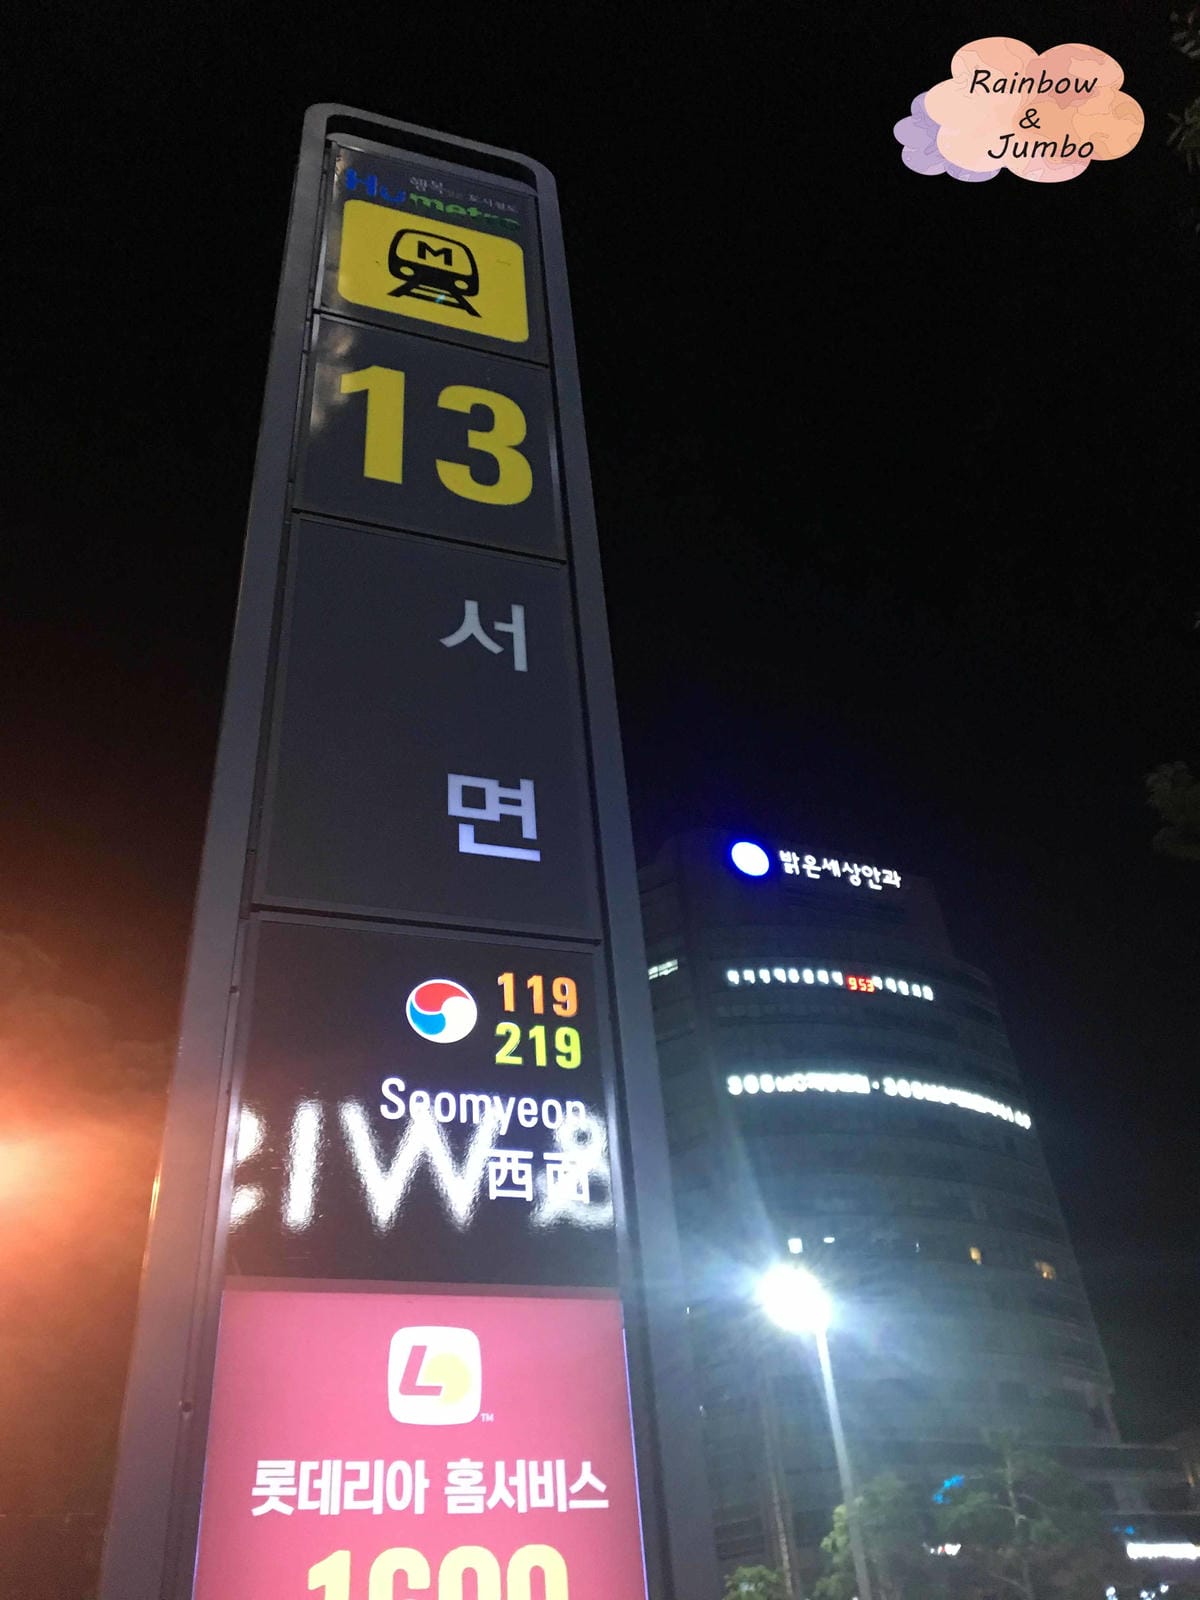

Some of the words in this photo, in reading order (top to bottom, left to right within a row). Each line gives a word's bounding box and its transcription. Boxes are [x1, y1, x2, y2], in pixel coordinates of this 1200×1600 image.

[416, 240, 453, 267] M
[339, 364, 534, 506] 13
[439, 599, 541, 862] 서면
[497, 972, 578, 1018] 119
[495, 1022, 582, 1069] 219
[380, 1077, 586, 1135] Seomyeon
[251, 1458, 430, 1516] 롯데리아
[443, 1457, 610, 1514] 홈서비스
